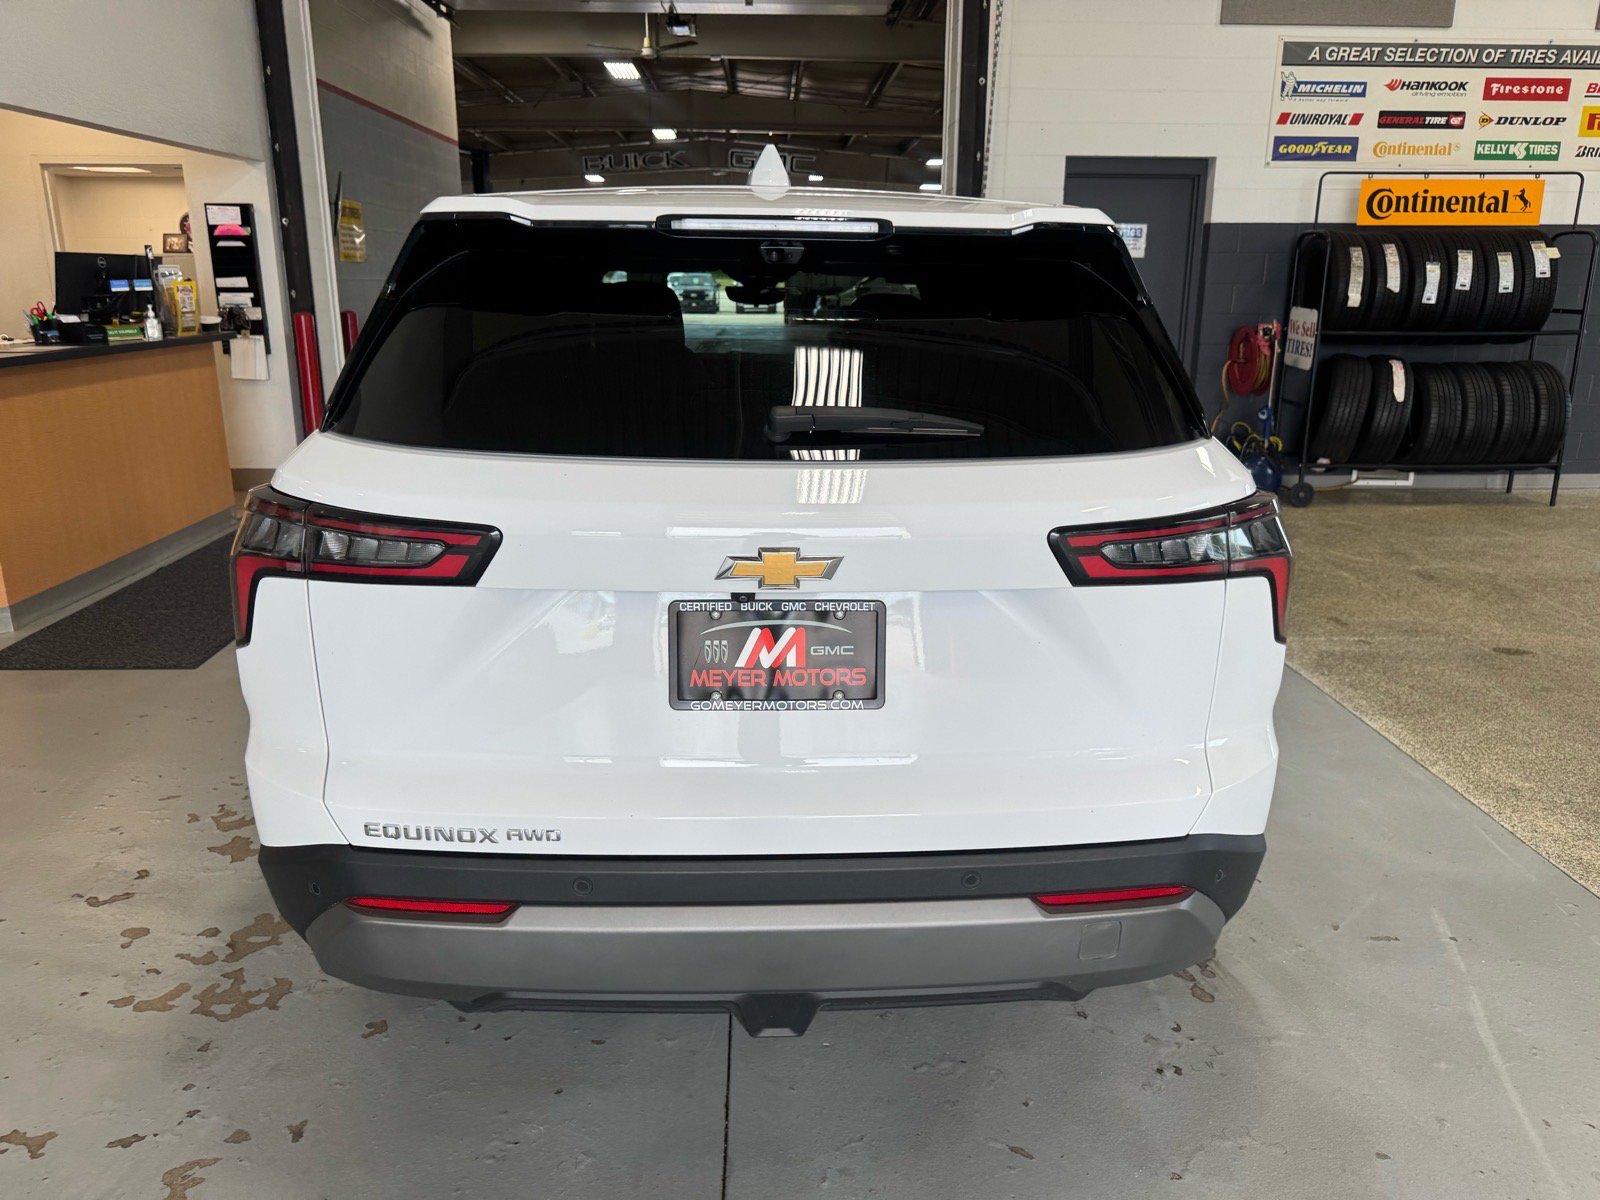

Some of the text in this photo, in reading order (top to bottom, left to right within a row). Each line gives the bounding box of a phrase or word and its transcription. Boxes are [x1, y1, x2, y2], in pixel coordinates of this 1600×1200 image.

[1308, 46, 1320, 61] A
[1325, 47, 1382, 62] GREAT
[1384, 47, 1479, 63] SELECTION
[1482, 49, 1506, 64] OF
[1510, 49, 1558, 64] TIRES
[1297, 84, 1364, 94] MICHELIN
[1490, 83, 1564, 96] Firestone
[1289, 113, 1347, 125] UNIROYAL
[1379, 116, 1424, 124] GENERAL
[1424, 116, 1448, 125] TIRE
[1494, 116, 1567, 126] DUNLOP
[1278, 142, 1352, 156] GOODYEAR
[1373, 141, 1453, 158] Continental
[1476, 143, 1508, 155] KELLY
[1528, 144, 1558, 155] TIRES
[582, 149, 817, 175] BUICK GC
[1366, 187, 1510, 220] Continental
[1289, 319, 1316, 338] We Sell
[1286, 338, 1313, 358] TIRES!
[679, 602, 876, 611] CERTIFIED BUICK GMC CHEVROLET
[810, 645, 855, 656] GMC
[689, 668, 867, 688] MEYER MOTORS
[690, 700, 865, 711] GOMEYERMOTORS.COM
[363, 821, 562, 844] EQUINOX AWD
